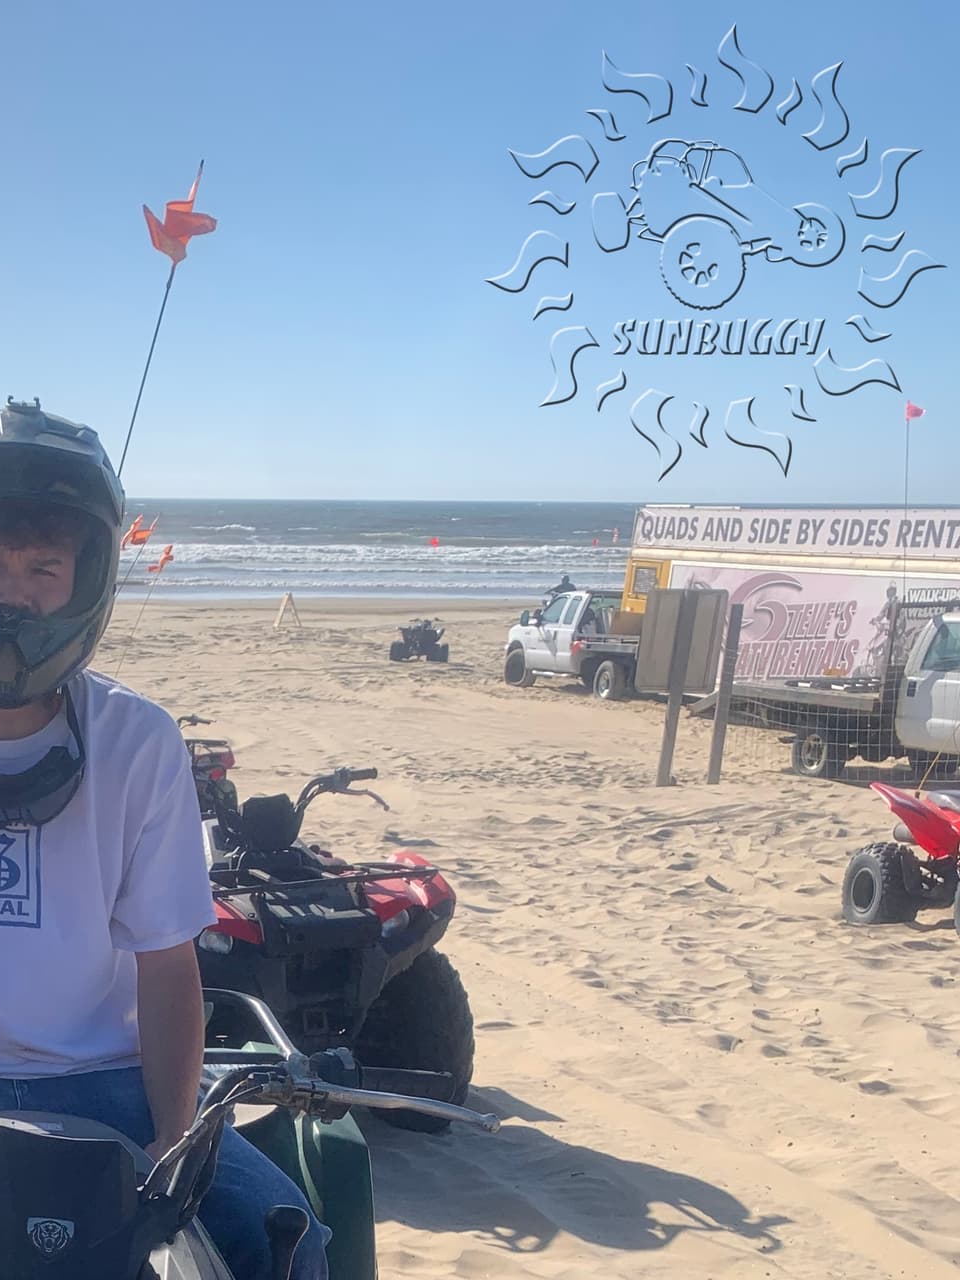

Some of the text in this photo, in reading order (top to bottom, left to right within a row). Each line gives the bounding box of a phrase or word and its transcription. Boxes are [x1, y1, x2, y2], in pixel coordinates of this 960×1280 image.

[641, 516, 699, 541] QUADS
[701, 517, 743, 542] AND
[747, 518, 792, 544] SIDE
[796, 519, 825, 545] BY
[827, 519, 890, 547] SIDES
[768, 639, 859, 678] RENTALS
